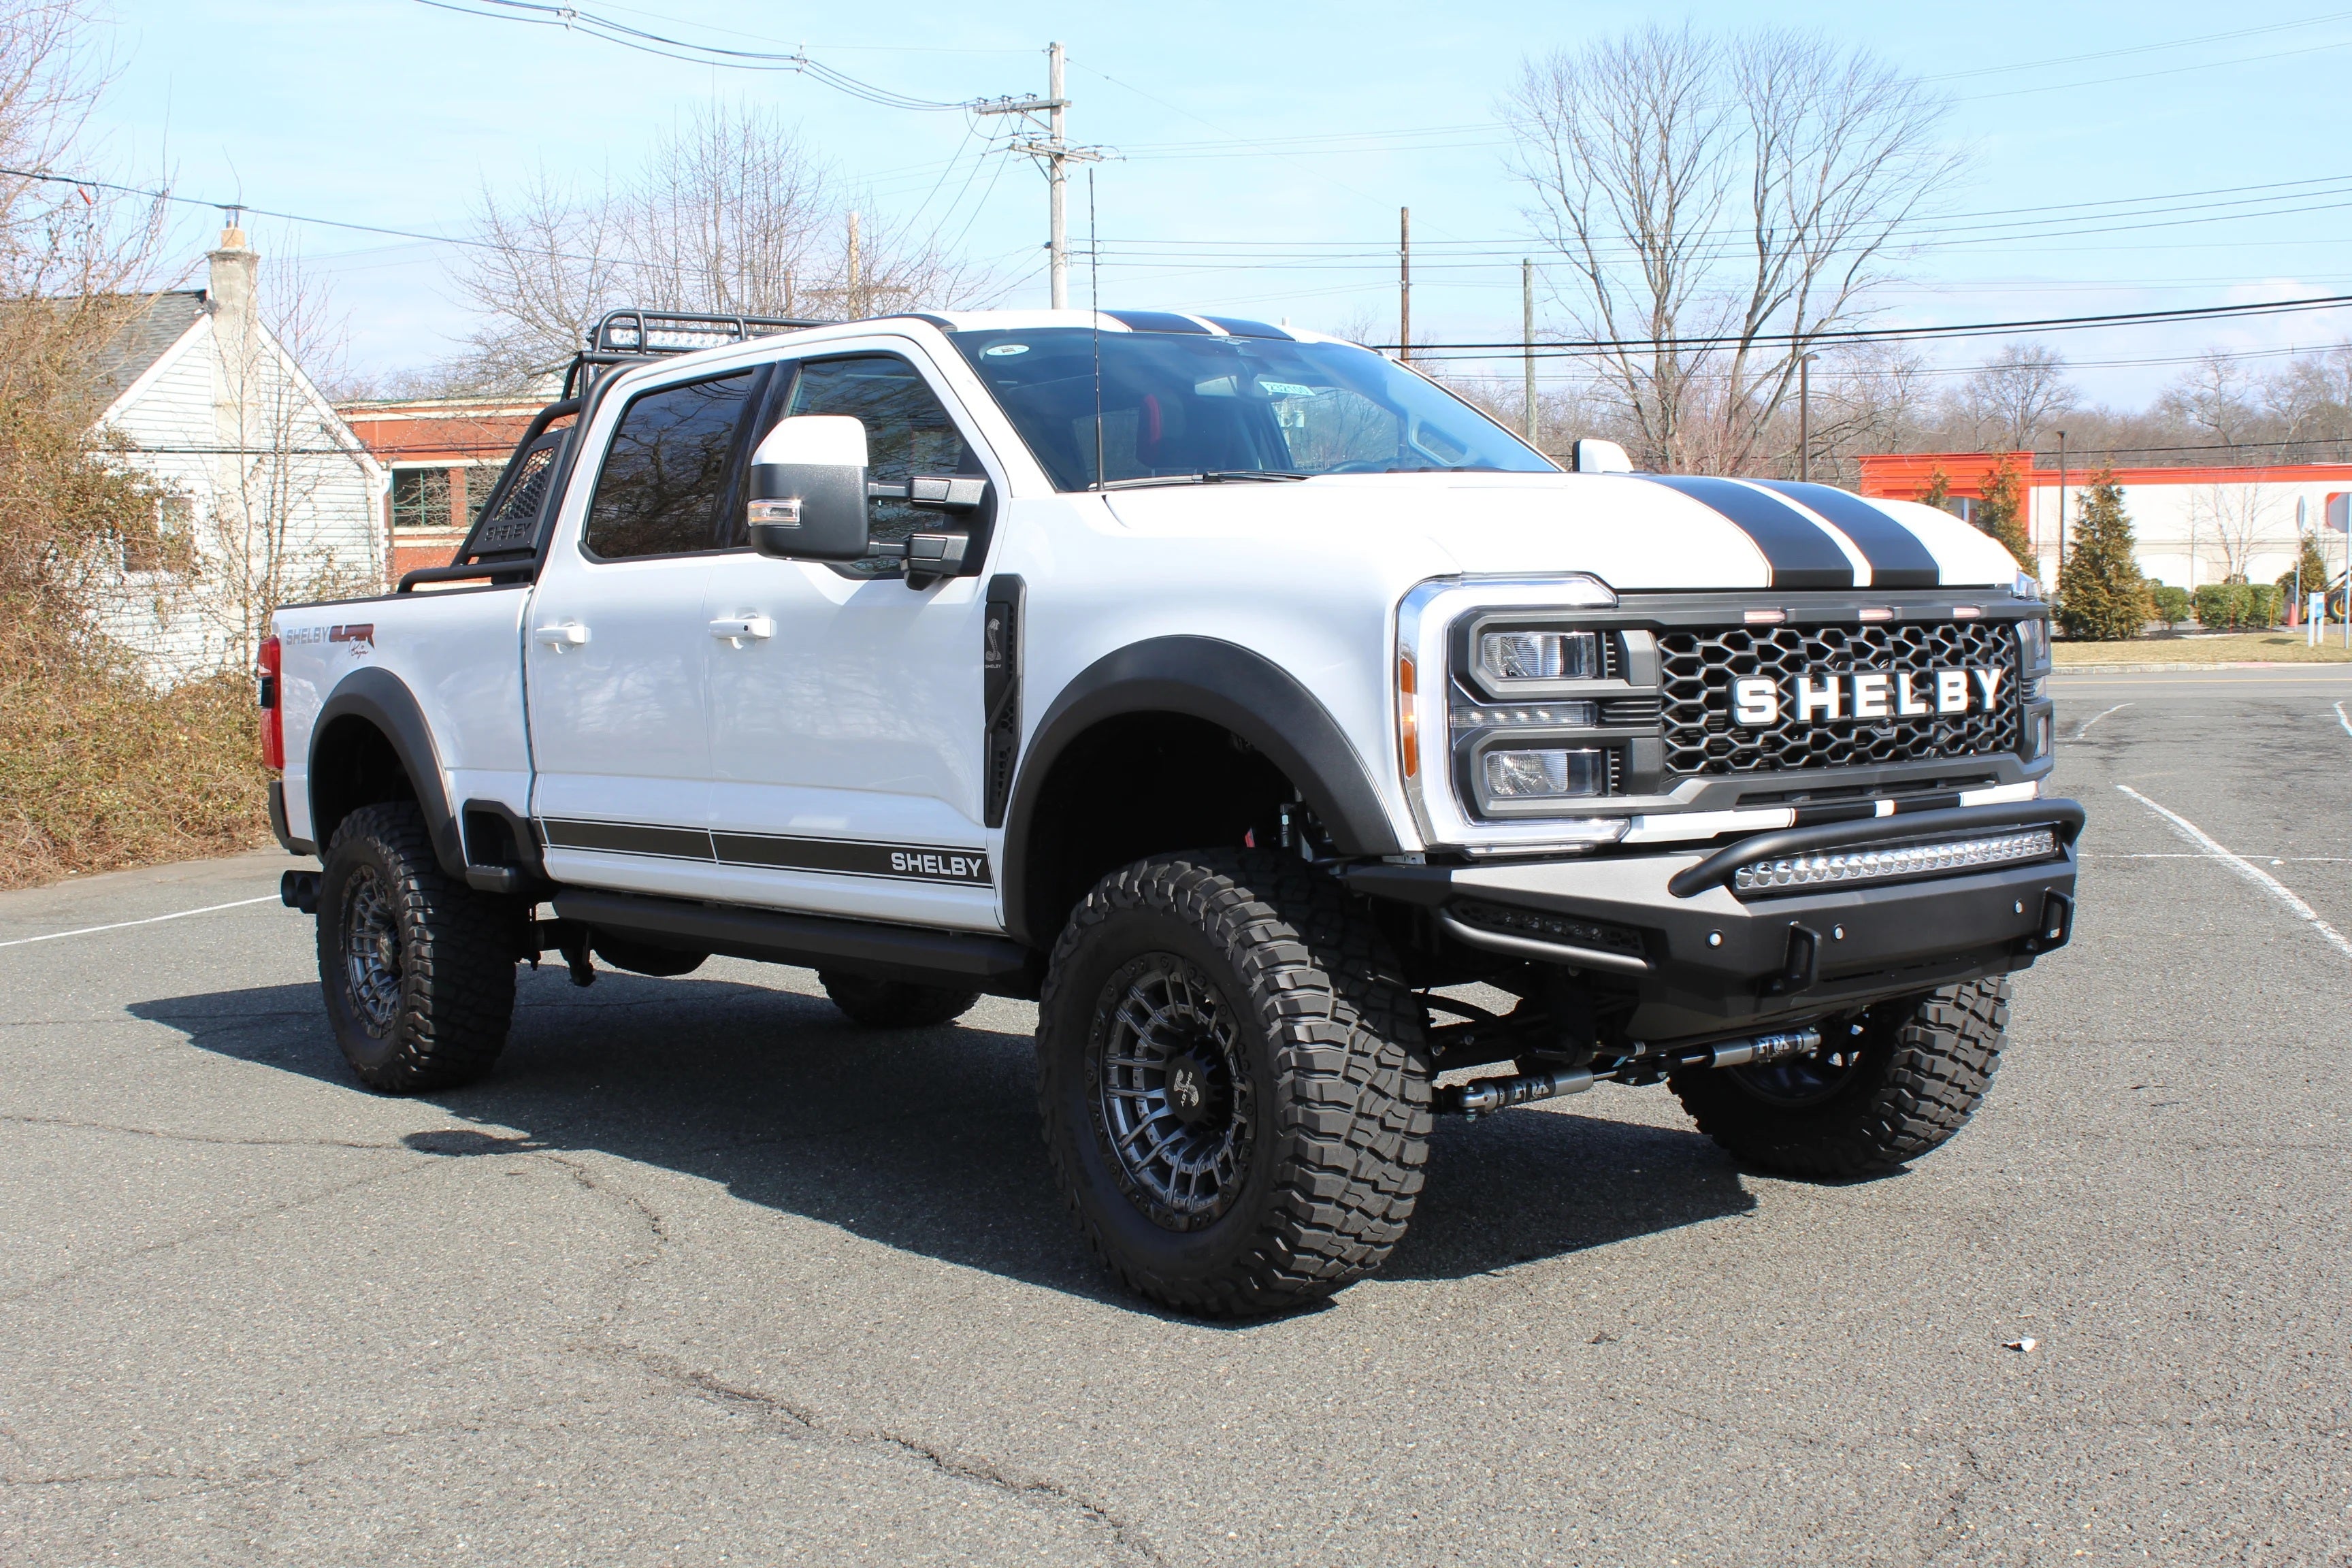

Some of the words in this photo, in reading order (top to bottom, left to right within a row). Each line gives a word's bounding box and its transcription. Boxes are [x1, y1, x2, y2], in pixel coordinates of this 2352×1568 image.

[287, 626, 330, 645] SHELBY
[1733, 666, 2002, 725] SHELBY
[891, 852, 982, 877] SHELBY
[1180, 1071, 1193, 1107] SHELBY
